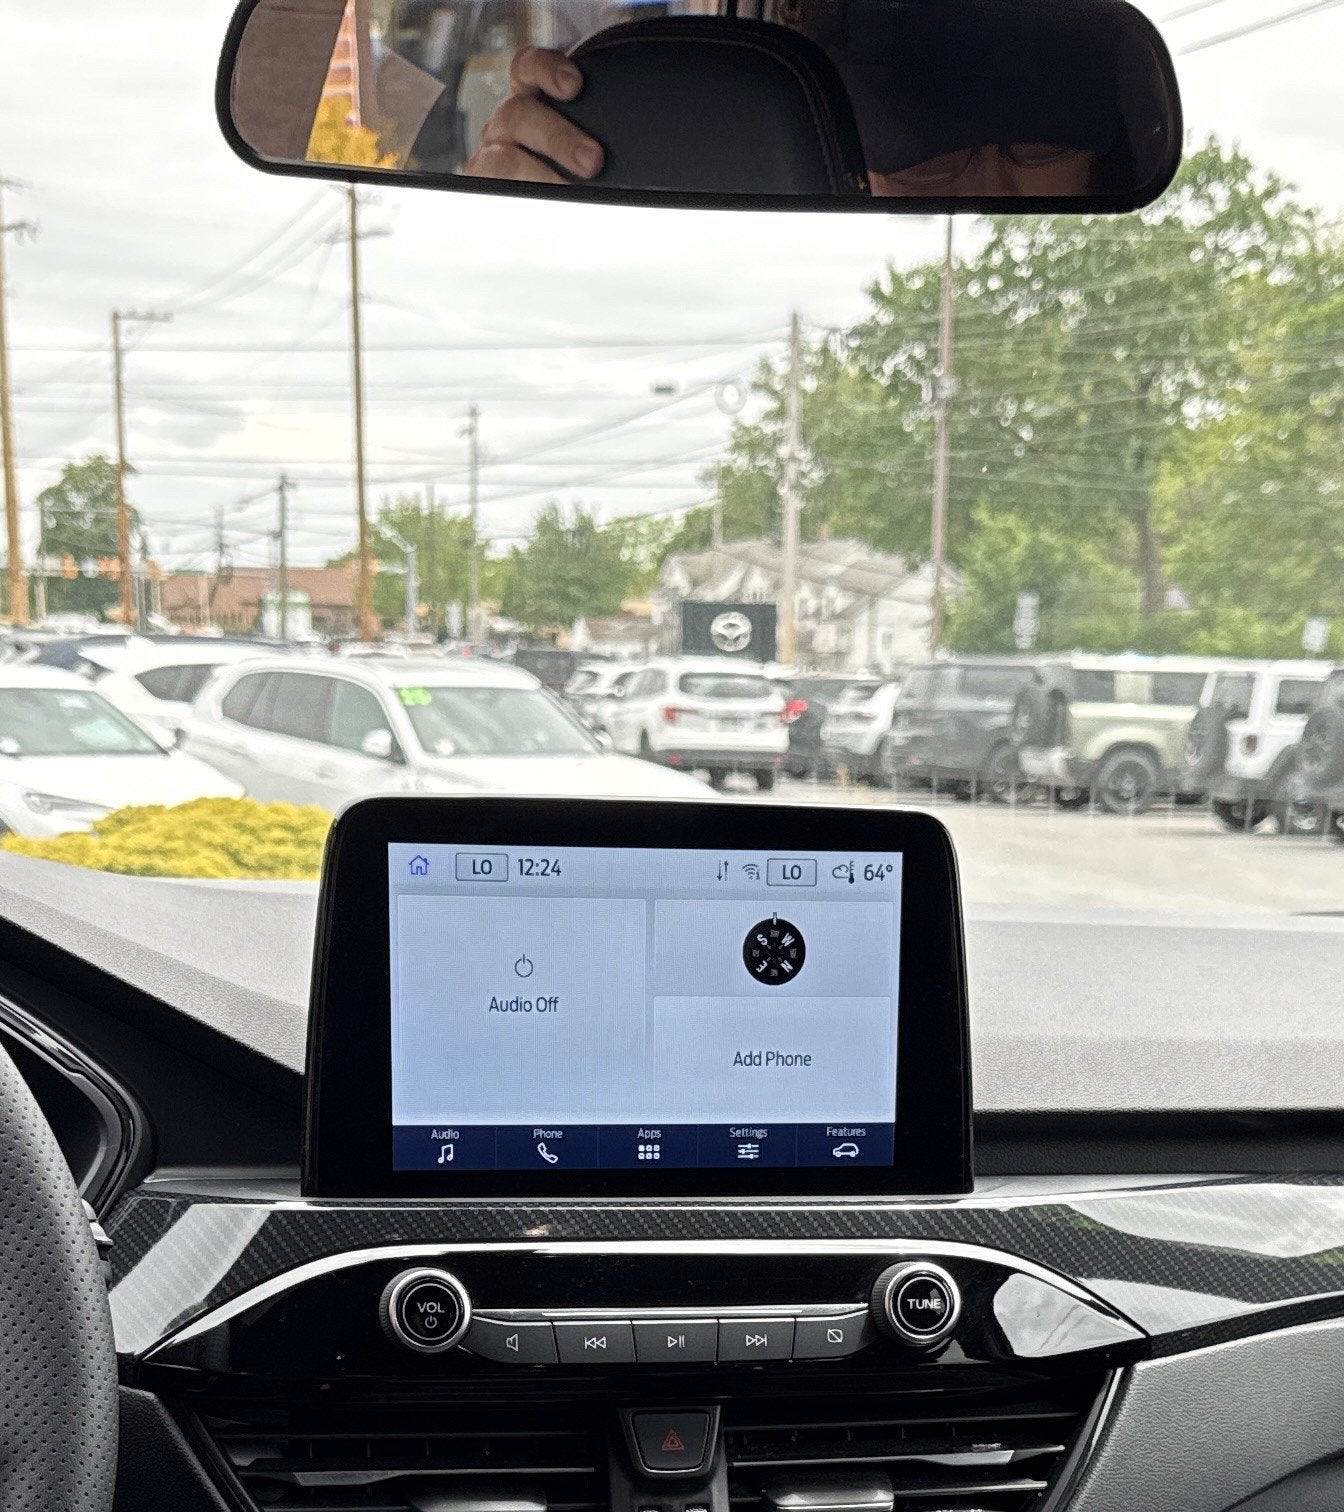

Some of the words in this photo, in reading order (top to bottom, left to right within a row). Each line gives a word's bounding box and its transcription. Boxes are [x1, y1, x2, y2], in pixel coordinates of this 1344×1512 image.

[471, 858, 493, 875] LO
[517, 858, 562, 877] 12:24
[782, 864, 802, 880] LO
[863, 863, 893, 882] 64°
[488, 995, 533, 1013] Audio
[536, 996, 560, 1013] Off
[732, 1050, 762, 1067] Add
[765, 1050, 812, 1067] Phone
[430, 1128, 460, 1140] Audio
[532, 1128, 563, 1140] Phone
[637, 1127, 662, 1140] Apps
[729, 1126, 769, 1140] Settings
[826, 1126, 867, 1138] Features
[415, 1300, 446, 1314] VOL
[906, 1297, 942, 1312] TUNE
